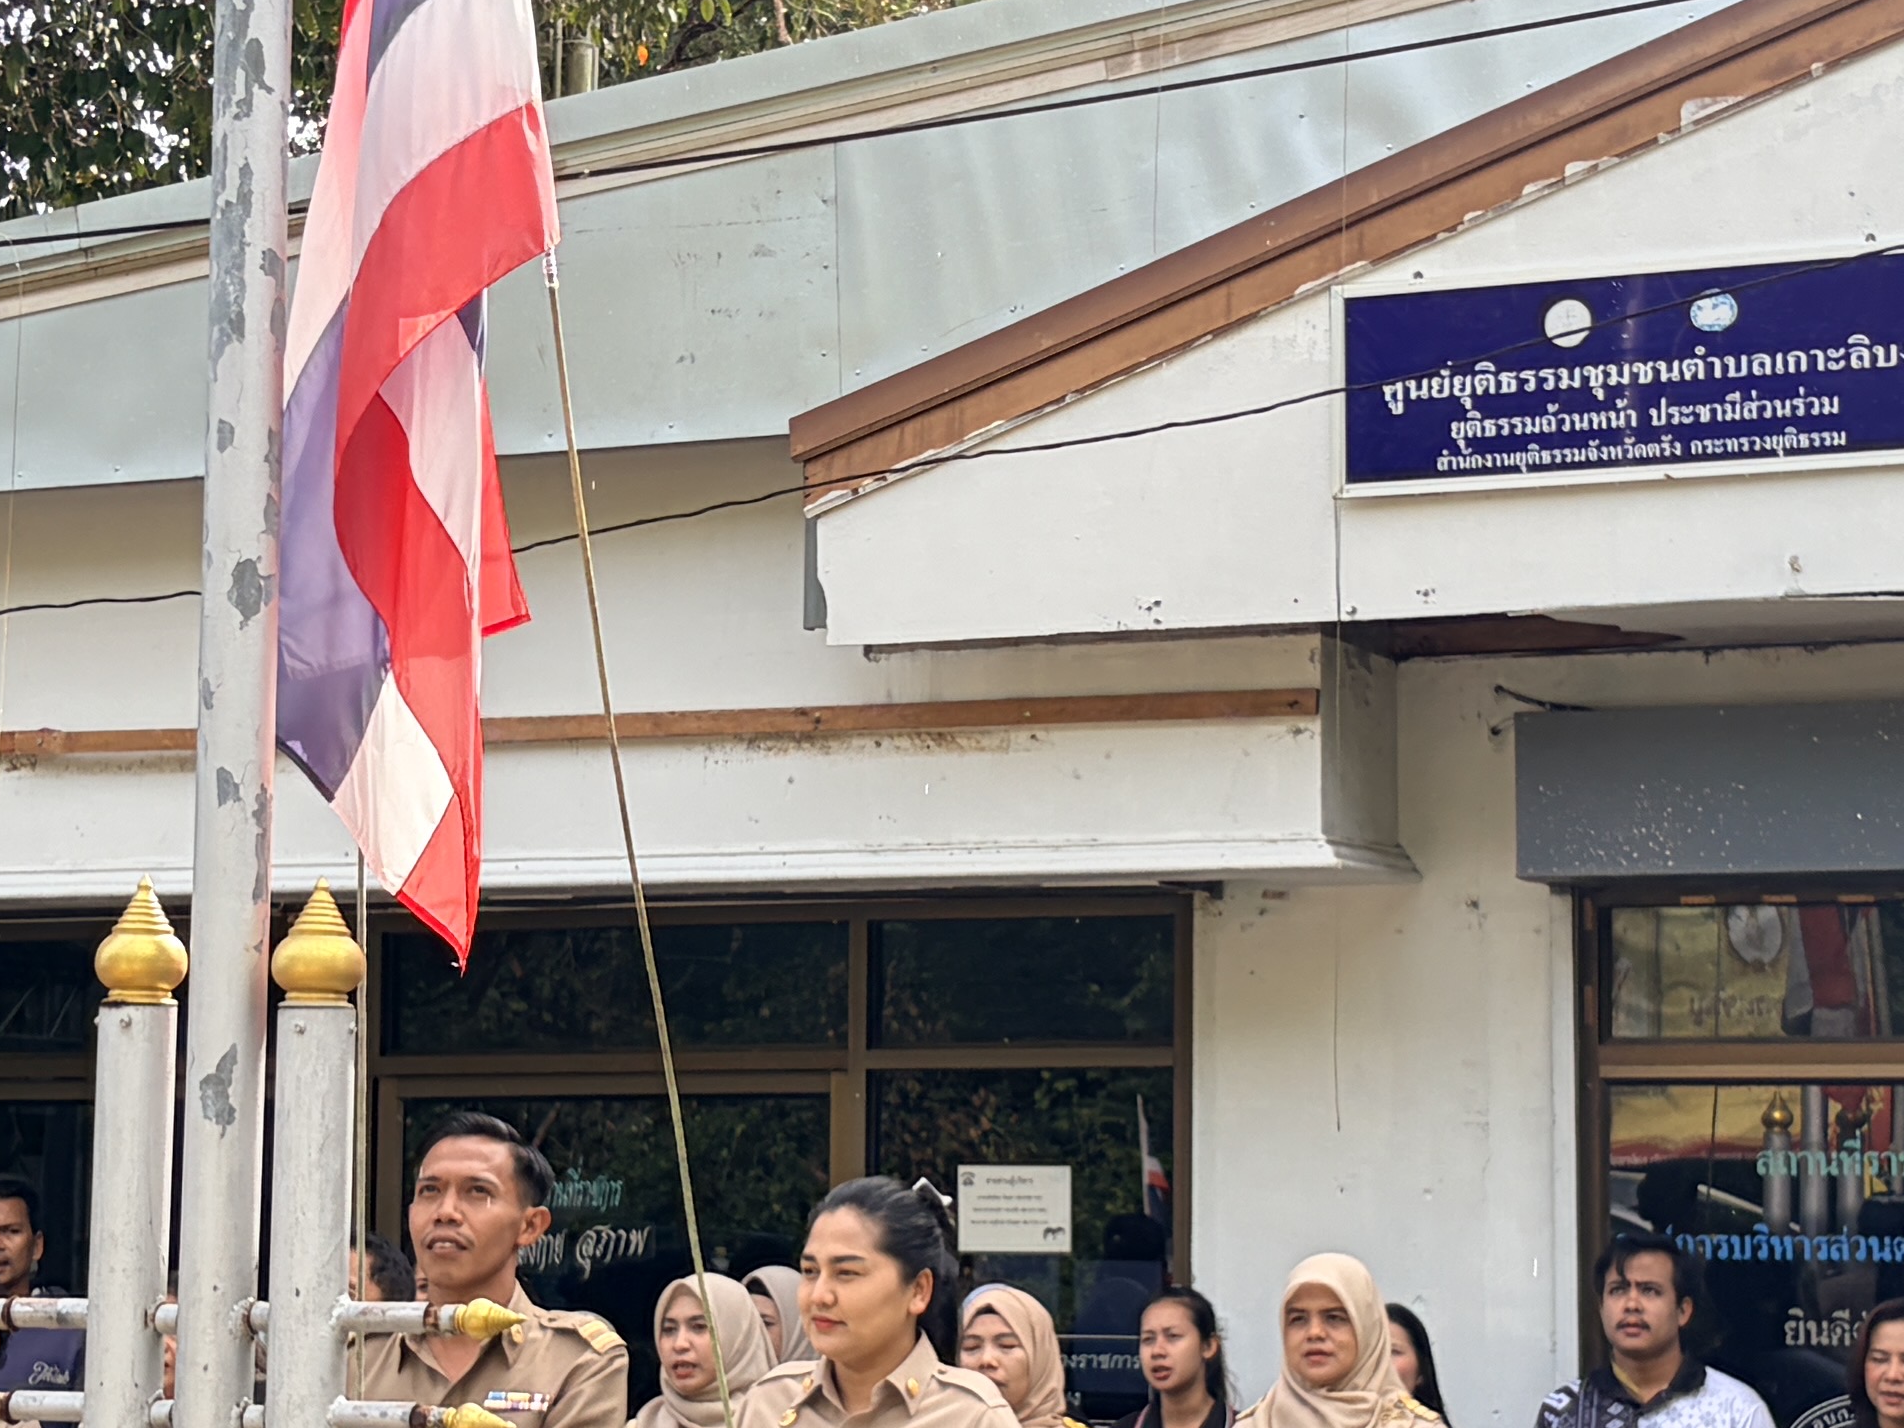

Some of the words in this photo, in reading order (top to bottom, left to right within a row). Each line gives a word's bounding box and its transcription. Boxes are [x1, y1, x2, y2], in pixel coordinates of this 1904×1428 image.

[1451, 398, 1637, 453] ยุติธรรมถ้วนหน้า
[1649, 386, 1839, 427] ประชามีส่วนร่วม
[1436, 434, 1681, 474] สำนักงานยุติธรรมจังหวัดตรัง
[1690, 426, 1846, 457] กระทรวงยุติธรรม
